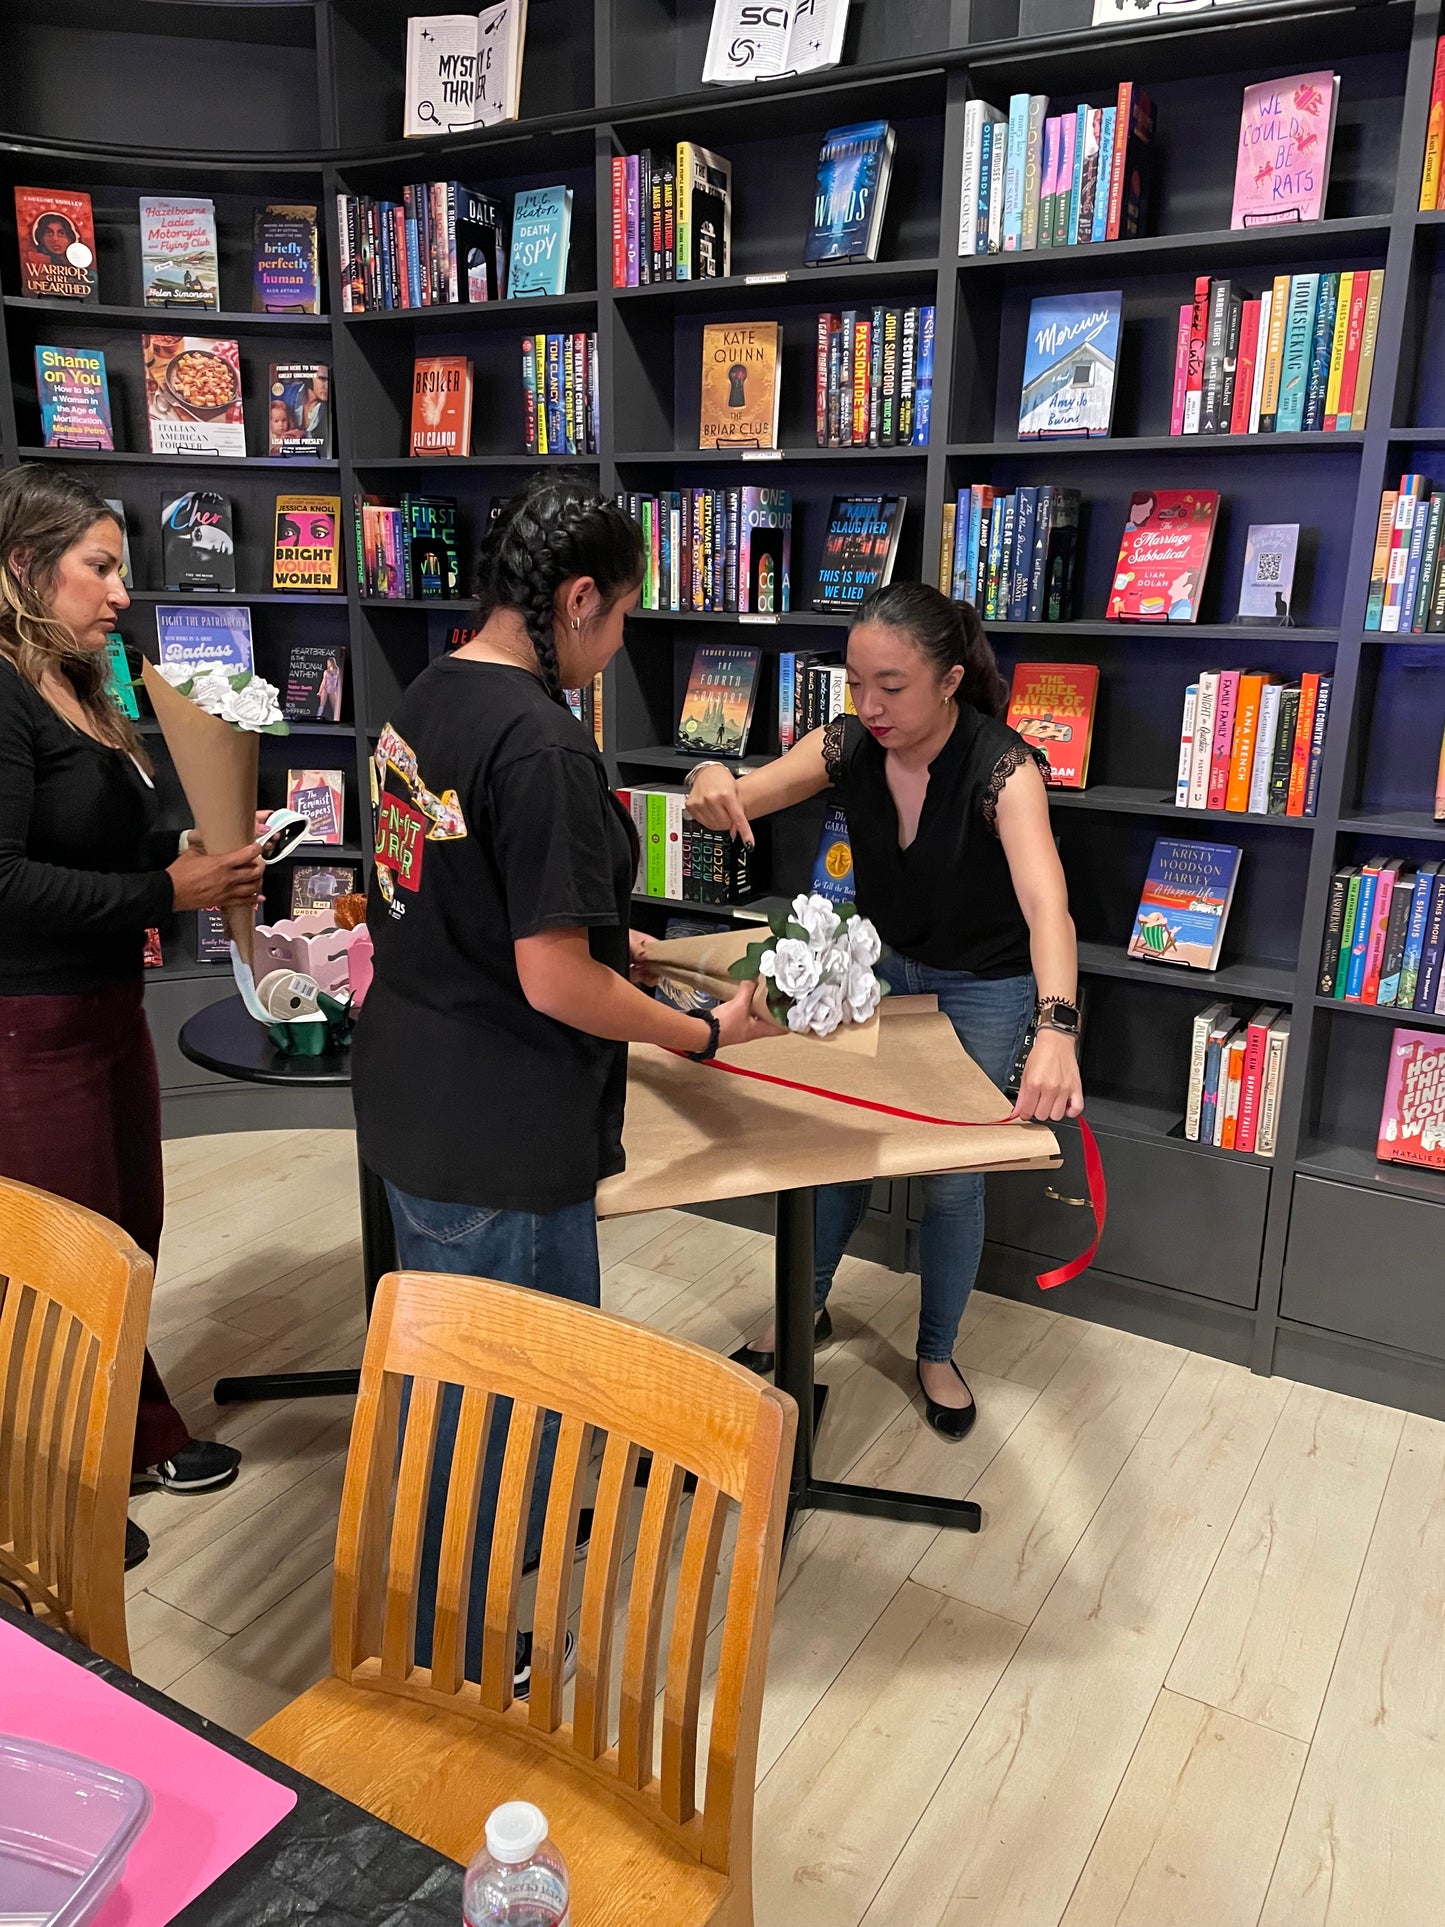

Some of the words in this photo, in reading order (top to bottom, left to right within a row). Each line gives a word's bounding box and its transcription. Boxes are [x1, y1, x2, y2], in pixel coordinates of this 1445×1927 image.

[740, 7, 788, 31] SCI
[1258, 94, 1283, 117] WE
[995, 133, 1003, 150] SALT
[1243, 118, 1300, 147] COULD
[982, 125, 990, 160] OTHER
[1275, 143, 1293, 169] BE
[964, 151, 973, 191] DREAM
[993, 153, 1002, 182] HOUSES
[980, 166, 988, 196] BIRDS
[1273, 170, 1314, 201] RATS
[653, 186, 661, 209] JAMES
[664, 184, 673, 207] JAMES
[145, 206, 207, 217] Hazelbourne
[469, 200, 495, 225] DALE
[515, 206, 559, 221] Beaton
[961, 195, 971, 235] COUNT
[161, 217, 195, 228] Ladies
[520, 223, 551, 238] DEATH
[653, 211, 661, 251] PATTERSON
[665, 210, 673, 249] PATTERSON
[148, 228, 207, 241] Motorcycle
[264, 242, 303, 255] briefly
[513, 243, 523, 252] OF
[514, 252, 521, 261] A
[523, 233, 558, 267] SPY
[26, 262, 94, 283] WARRIOR
[258, 259, 309, 272] perfectly
[28, 279, 91, 295] UNEARTHED
[46, 275, 68, 283] GIRL
[263, 274, 304, 284] human
[150, 288, 171, 299] Helen
[172, 289, 213, 299] Simonson
[1214, 288, 1225, 318] HARBOR
[1275, 284, 1285, 316] SWIFT
[1316, 282, 1329, 336] CHEVALIER
[885, 313, 896, 340] JOHN
[903, 312, 914, 335] LISA
[1035, 309, 1110, 355] Mercury
[1287, 281, 1311, 370] HOMESEEKING
[723, 331, 755, 346] KATE
[1212, 321, 1222, 346] LIGHTS
[1270, 321, 1282, 353] RIVER
[550, 340, 558, 361] TOM
[714, 349, 764, 363] QUINN
[42, 351, 100, 370] Shame
[854, 325, 865, 405] PASSIONTIDE
[883, 343, 895, 395] SANDFORD
[901, 337, 912, 398] SCOTTOLINE
[1209, 357, 1218, 378] JAMES
[44, 372, 65, 384] on
[70, 371, 101, 386] You
[416, 371, 460, 393] BROILER
[550, 364, 558, 403] CLANCY
[1208, 378, 1217, 391] LEE
[54, 385, 71, 394] How
[74, 386, 81, 394] to
[84, 387, 95, 395] Be
[1223, 377, 1232, 406] Kindred
[1306, 360, 1321, 425] GLASSMAKER
[57, 405, 69, 413] the
[72, 405, 87, 416] Age
[88, 407, 96, 415] of
[1206, 392, 1215, 413] BURKE
[53, 415, 102, 425] Mortification
[730, 412, 742, 420] THE
[158, 424, 197, 433] ITALIAN
[159, 433, 209, 442] AMERICAN
[704, 425, 735, 436] BRIAR
[739, 422, 769, 435] CLUB
[760, 488, 785, 505] ONE
[1432, 497, 1441, 514] HOW
[169, 496, 224, 530] Cher
[310, 505, 335, 513] KNOLL
[412, 506, 456, 524] FIRST
[704, 496, 712, 523] RUTH
[749, 510, 765, 528] OF
[768, 511, 792, 528] OUR
[830, 521, 887, 534] SLAUGHTER
[1004, 508, 1014, 545] CLEAR
[1430, 515, 1439, 525] WE
[704, 525, 712, 555] WARE
[1133, 532, 1192, 548] Marriage
[1427, 526, 1438, 550] NAMED
[276, 548, 333, 561] BRIGHT
[1127, 546, 1190, 564] Sabbatical
[1426, 550, 1434, 563] THE
[276, 561, 332, 573] YOUNG
[819, 569, 840, 582] THIS
[842, 571, 853, 583] IS
[855, 571, 877, 584] WHY
[1422, 563, 1432, 583] STARS
[276, 573, 332, 585] WOMEN
[1015, 573, 1023, 602] DONATI
[1033, 572, 1041, 590] Enger
[824, 586, 840, 598] WE
[842, 586, 864, 599] LIED
[165, 643, 233, 660] Badass
[291, 647, 336, 656] HEARTBREAK
[289, 670, 318, 678] ANTHEM
[290, 662, 324, 670] NATIONAL
[718, 661, 732, 670] THE
[700, 674, 742, 687] FOURTH
[832, 676, 842, 702] IRON
[1040, 675, 1065, 684] THE
[693, 690, 744, 704] CONSORT
[1025, 684, 1077, 695] THREE
[1222, 679, 1232, 707] FAMILY
[1015, 694, 1059, 705] LIVES
[1064, 695, 1084, 706] OF
[1263, 691, 1272, 709] Lisa
[1317, 689, 1328, 711] GREAT
[1012, 705, 1048, 715] CATE
[1053, 706, 1086, 717] KAY
[1244, 705, 1254, 733] TANA
[1218, 711, 1227, 738] FAMILY
[1260, 712, 1270, 743] Genova
[1313, 713, 1325, 744] COUNTRY
[1238, 739, 1250, 780] FRENCH
[297, 791, 330, 812] Feminist
[1172, 848, 1214, 862] KRISTY
[1160, 858, 1222, 876] WOODSON
[1164, 871, 1211, 886] HARVEY
[1418, 879, 1427, 896] JILL
[1411, 900, 1424, 938] SHALVIS
[1422, 979, 1431, 1000] Shepherd
[1194, 1040, 1204, 1066] FOURS
[1189, 1077, 1201, 1115] MIRANDA
[1244, 1075, 1255, 1113] HAPPINESS
[1187, 1116, 1197, 1138] JULY
[1241, 1117, 1250, 1138] FALLS
[1393, 1149, 1433, 1162] NATALIE
